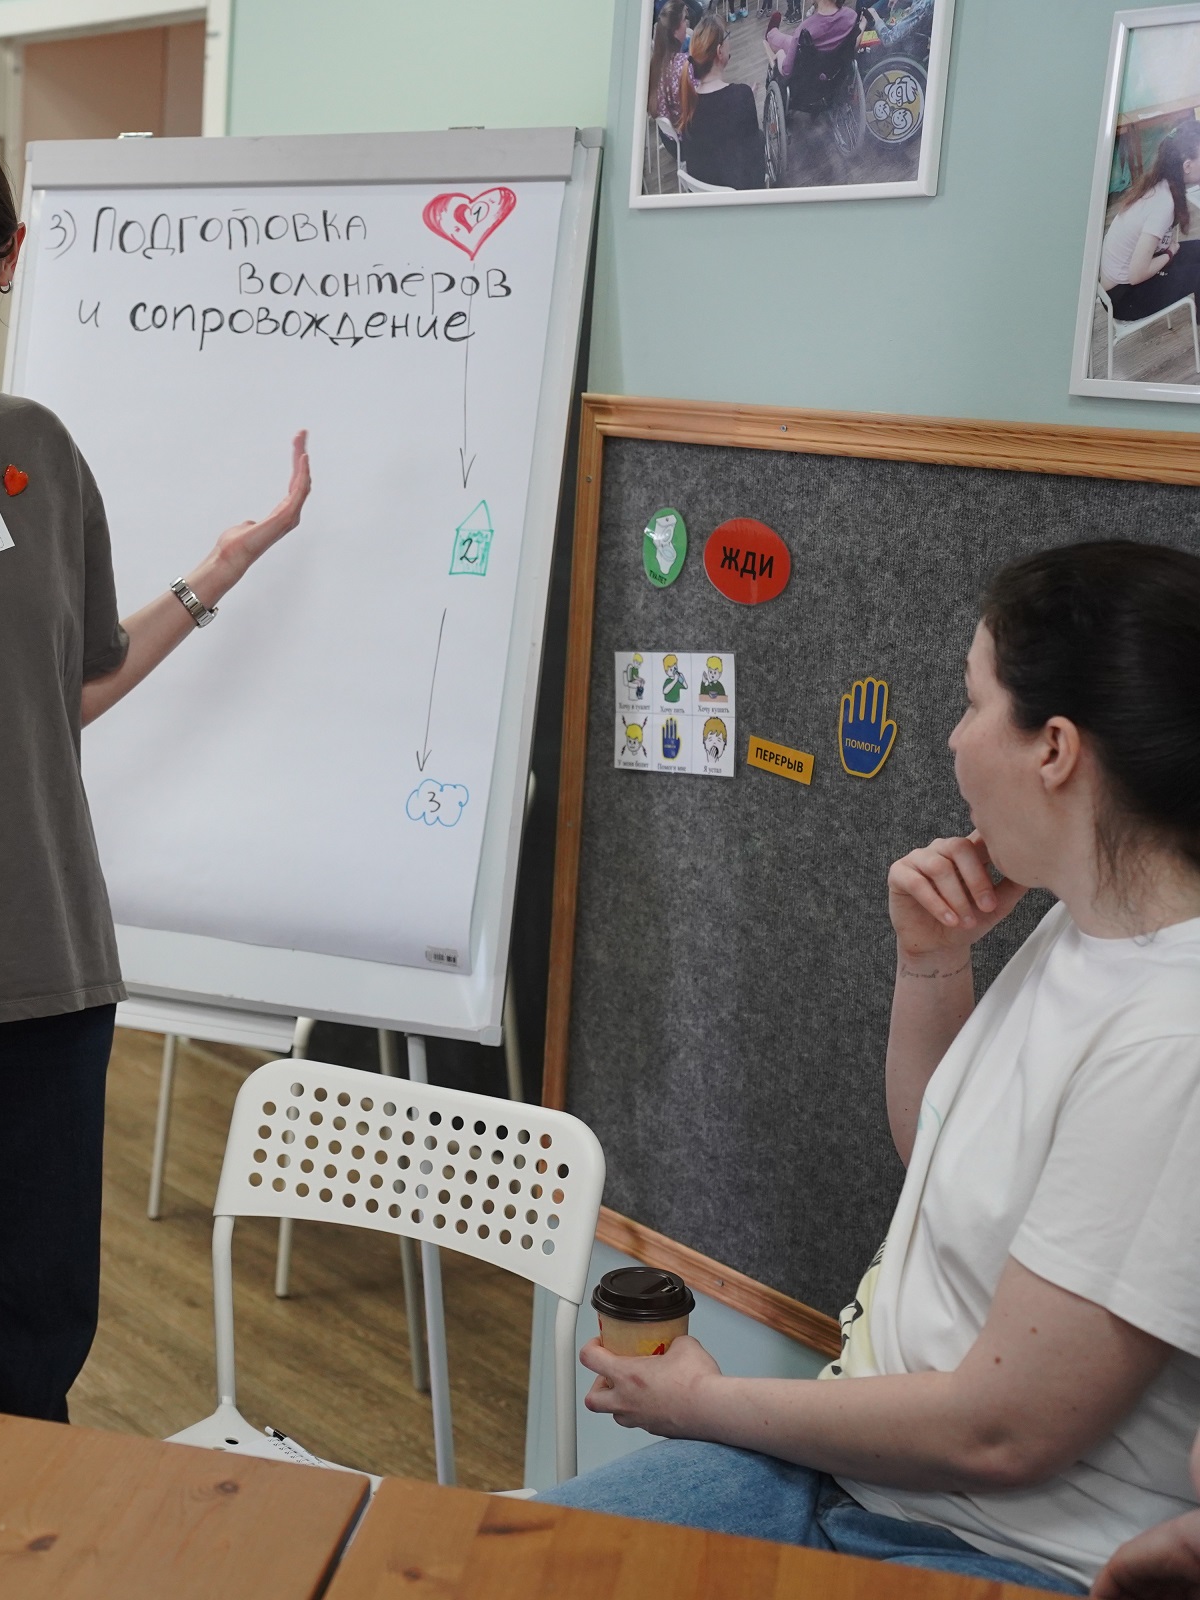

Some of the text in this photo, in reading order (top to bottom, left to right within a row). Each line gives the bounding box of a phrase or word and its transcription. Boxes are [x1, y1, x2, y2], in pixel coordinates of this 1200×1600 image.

[473, 206, 482, 223] 1
[45, 209, 77, 259] 3)
[129, 301, 477, 351] сопровождение
[459, 538, 478, 564] 2
[720, 546, 775, 580] ЖДИ
[845, 738, 881, 754] ПОМОГИ
[755, 747, 804, 773] ПЕРЕРЫВ
[427, 791, 442, 813] 3
